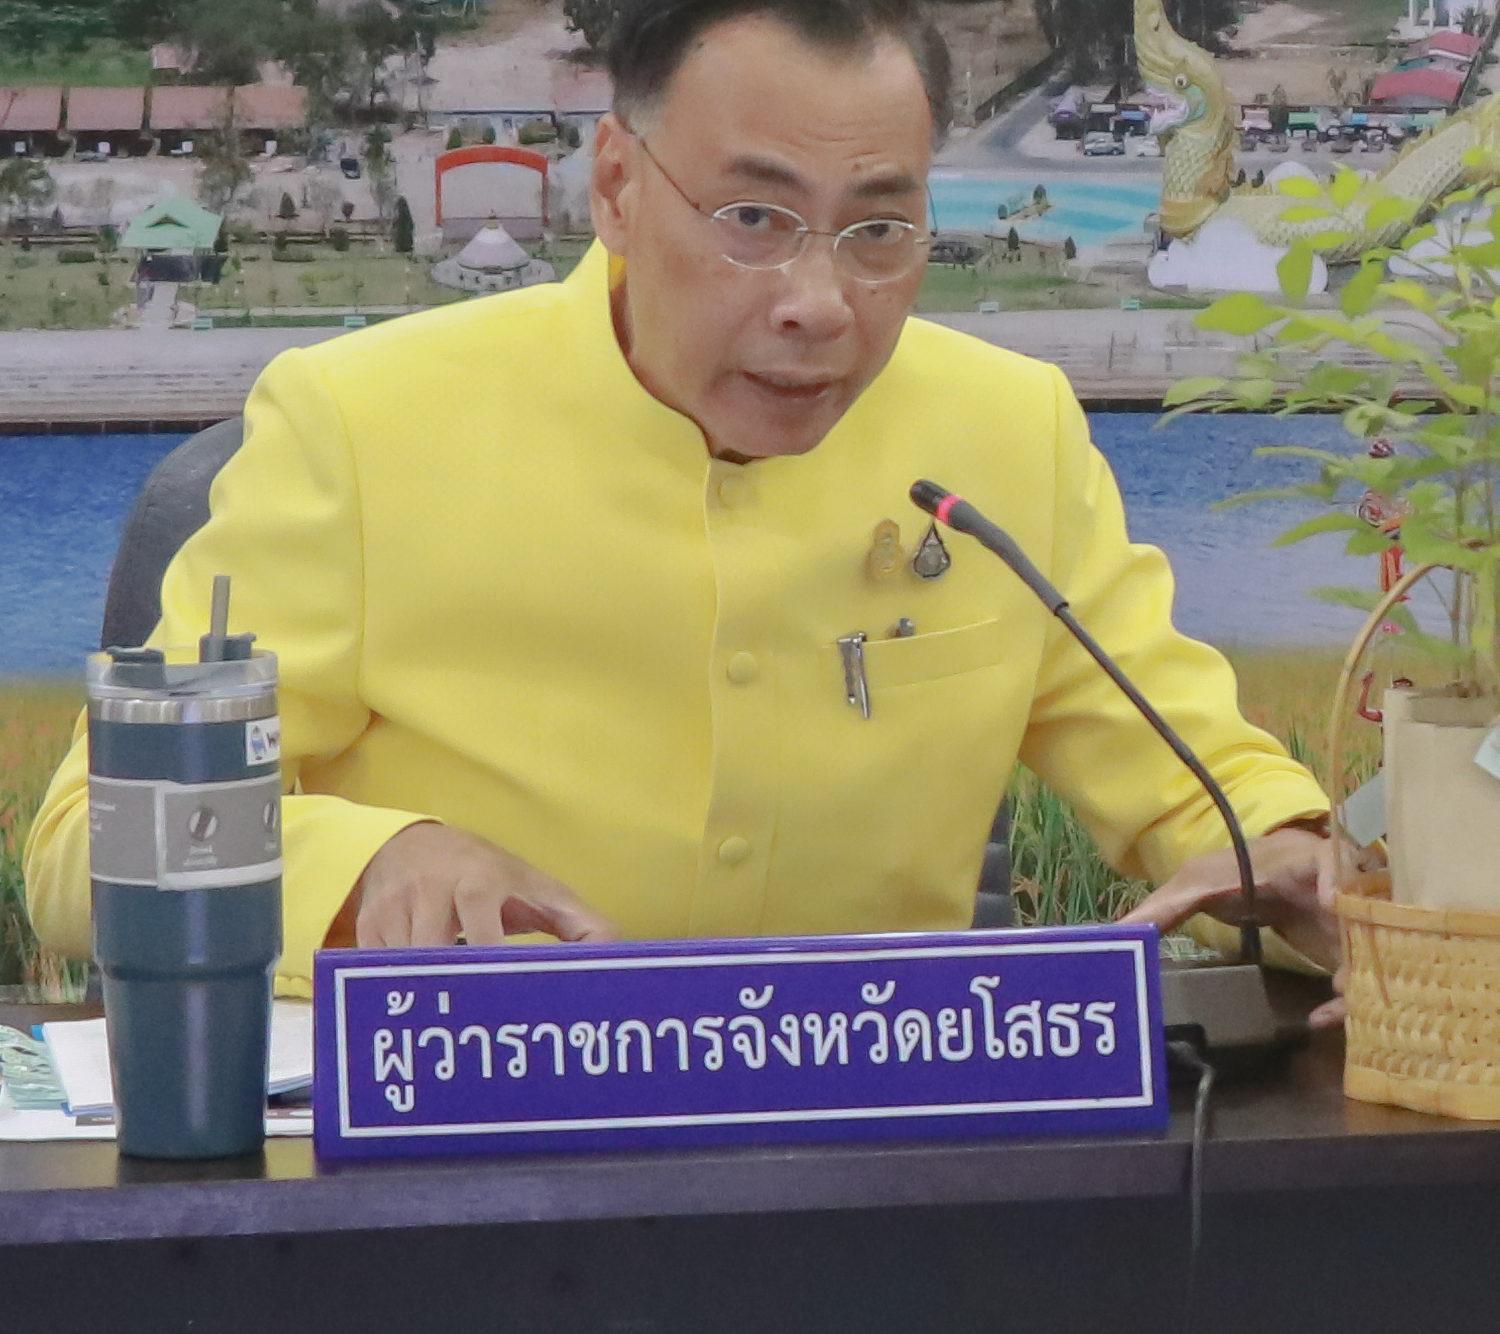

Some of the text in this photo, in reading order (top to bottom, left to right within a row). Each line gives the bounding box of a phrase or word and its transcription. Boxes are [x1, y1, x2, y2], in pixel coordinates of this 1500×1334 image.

[372, 975, 1118, 1113] ผู้ว่าราชการจังหวัดยโสธร
